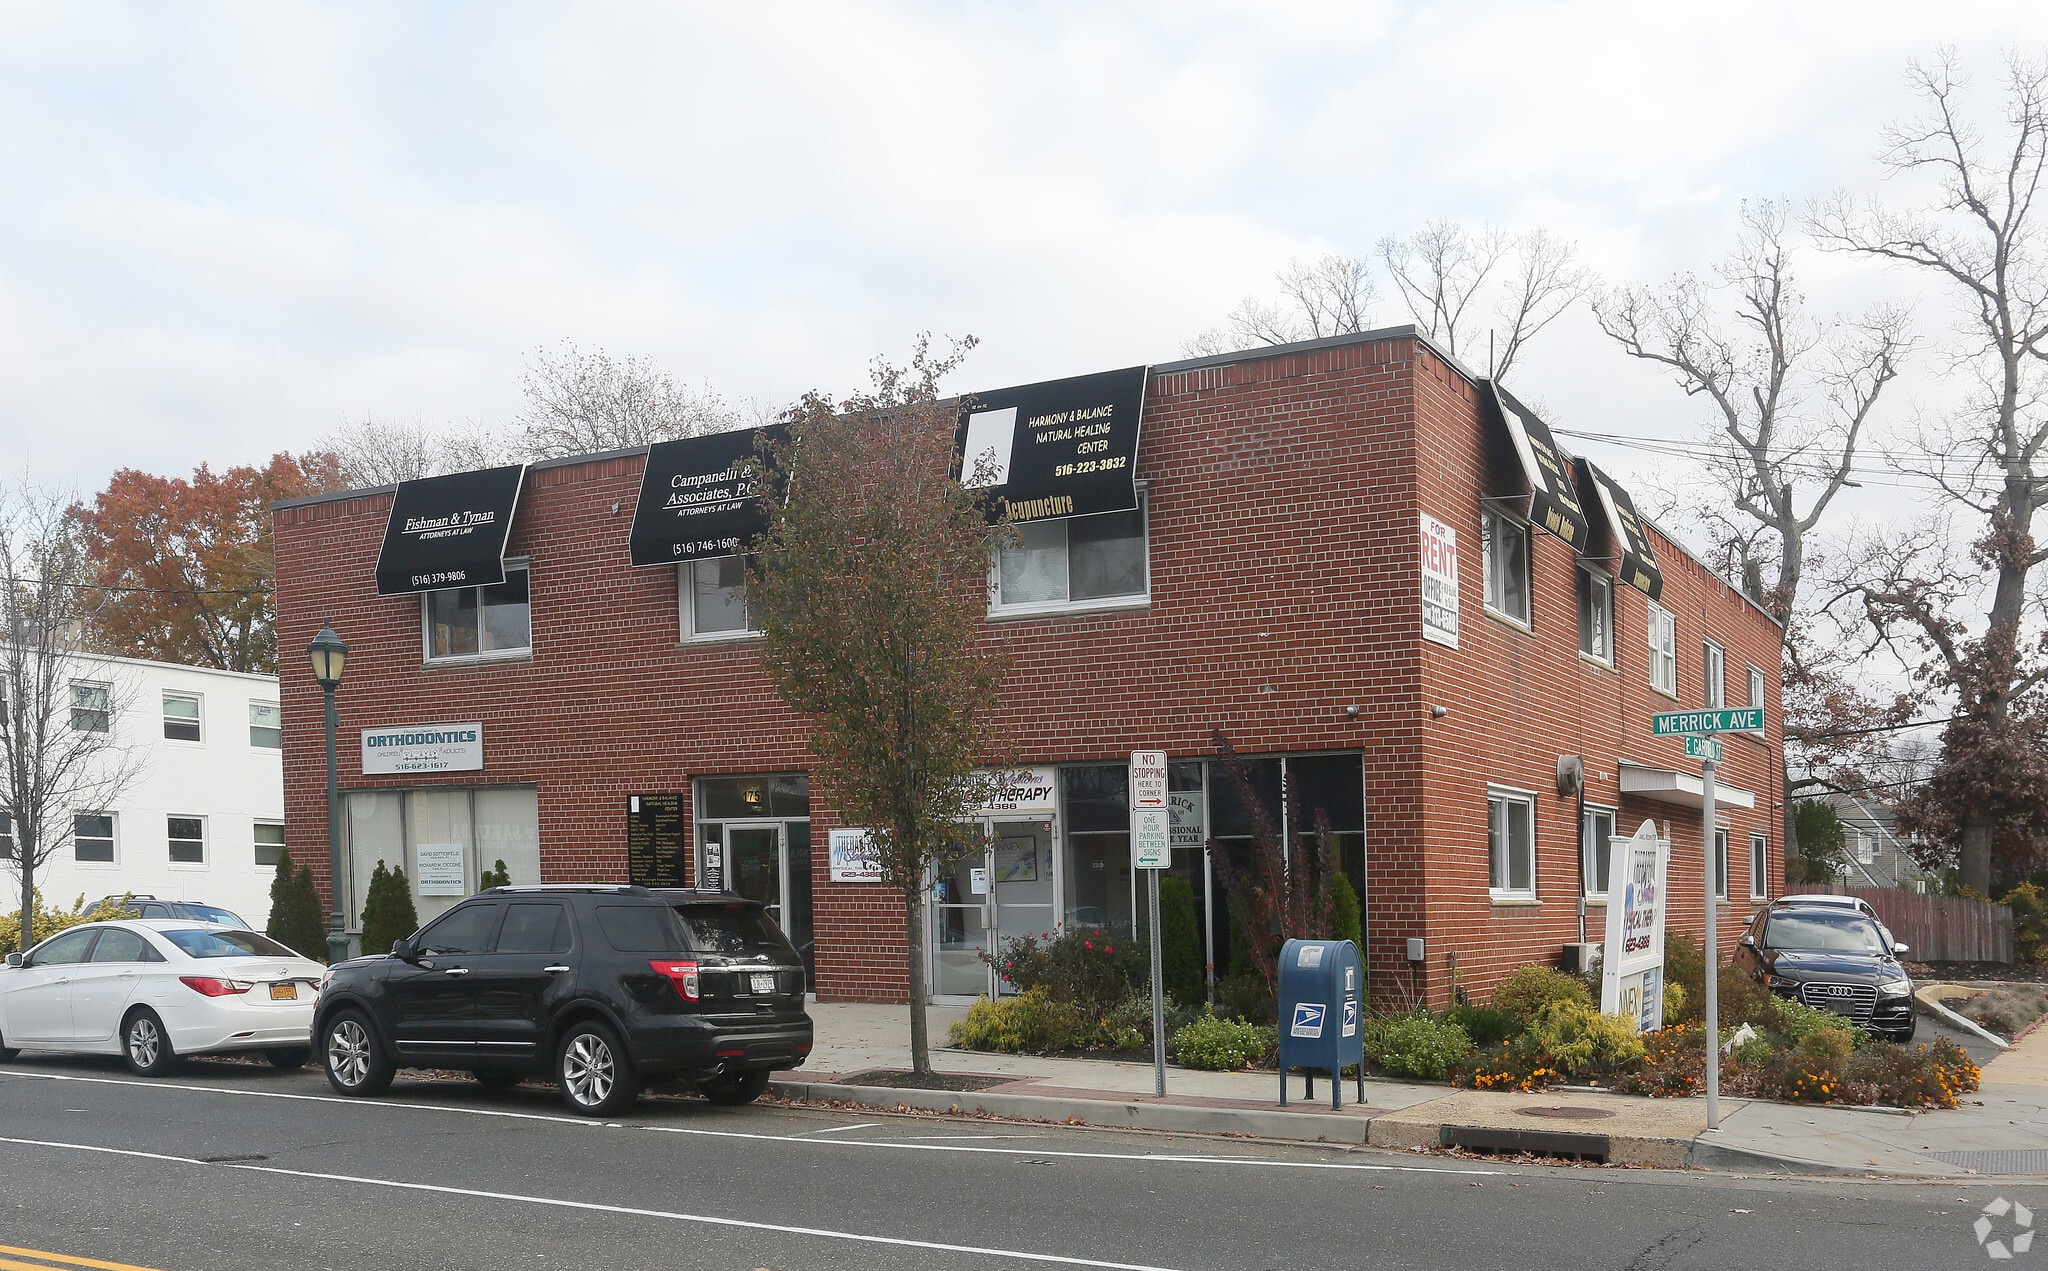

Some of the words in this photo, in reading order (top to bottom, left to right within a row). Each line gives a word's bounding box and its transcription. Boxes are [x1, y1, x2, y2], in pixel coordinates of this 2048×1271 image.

[1028, 412, 1068, 428] HARMONY
[1069, 411, 1075, 422] &
[1076, 404, 1114, 421] BALANCE
[1035, 427, 1073, 444] NATURAL
[1074, 422, 1111, 438] HEALING
[1077, 439, 1109, 455] CENTER
[1054, 456, 1127, 477] 516-223-3832
[670, 467, 738, 489] Campanelli
[666, 487, 732, 506] Associates,
[677, 505, 716, 517] ATTORNEYS
[716, 503, 726, 512] AT
[727, 502, 743, 511] LAW
[1004, 494, 1074, 520] Acupuncture
[404, 516, 448, 531] Fishman
[450, 512, 460, 525] &
[463, 510, 495, 526] Tynan
[419, 529, 452, 540] ATTORNEYS
[452, 528, 460, 536] AT
[460, 527, 474, 535] LAW
[1430, 521, 1446, 539] FOR
[672, 542, 695, 556] (516)
[697, 537, 738, 551] 746-1600
[1421, 530, 1455, 580] RENT
[411, 574, 431, 587] (516)
[432, 570, 466, 583] 379-9806
[1658, 712, 1722, 733] MERRICK
[1729, 711, 1757, 729] AVE
[367, 730, 477, 748] ORTHODONTICS
[1685, 737, 1691, 754] E
[1716, 744, 1722, 760] ST
[395, 762, 449, 771] 516-623-1617
[1142, 754, 1156, 766] NO
[1134, 767, 1165, 779] STOPPING
[1137, 780, 1152, 788] HERE
[1155, 780, 1162, 788] TO
[991, 786, 1054, 802] THERAPY
[1138, 789, 1162, 797] CORNER
[1143, 816, 1156, 824] ONE
[1143, 824, 1160, 832] HOUR
[1138, 840, 1166, 848] BETWEEN
[1139, 832, 1165, 840] PARKING
[1178, 835, 1199, 843] YEAR
[1143, 849, 1162, 857] SIGNS
